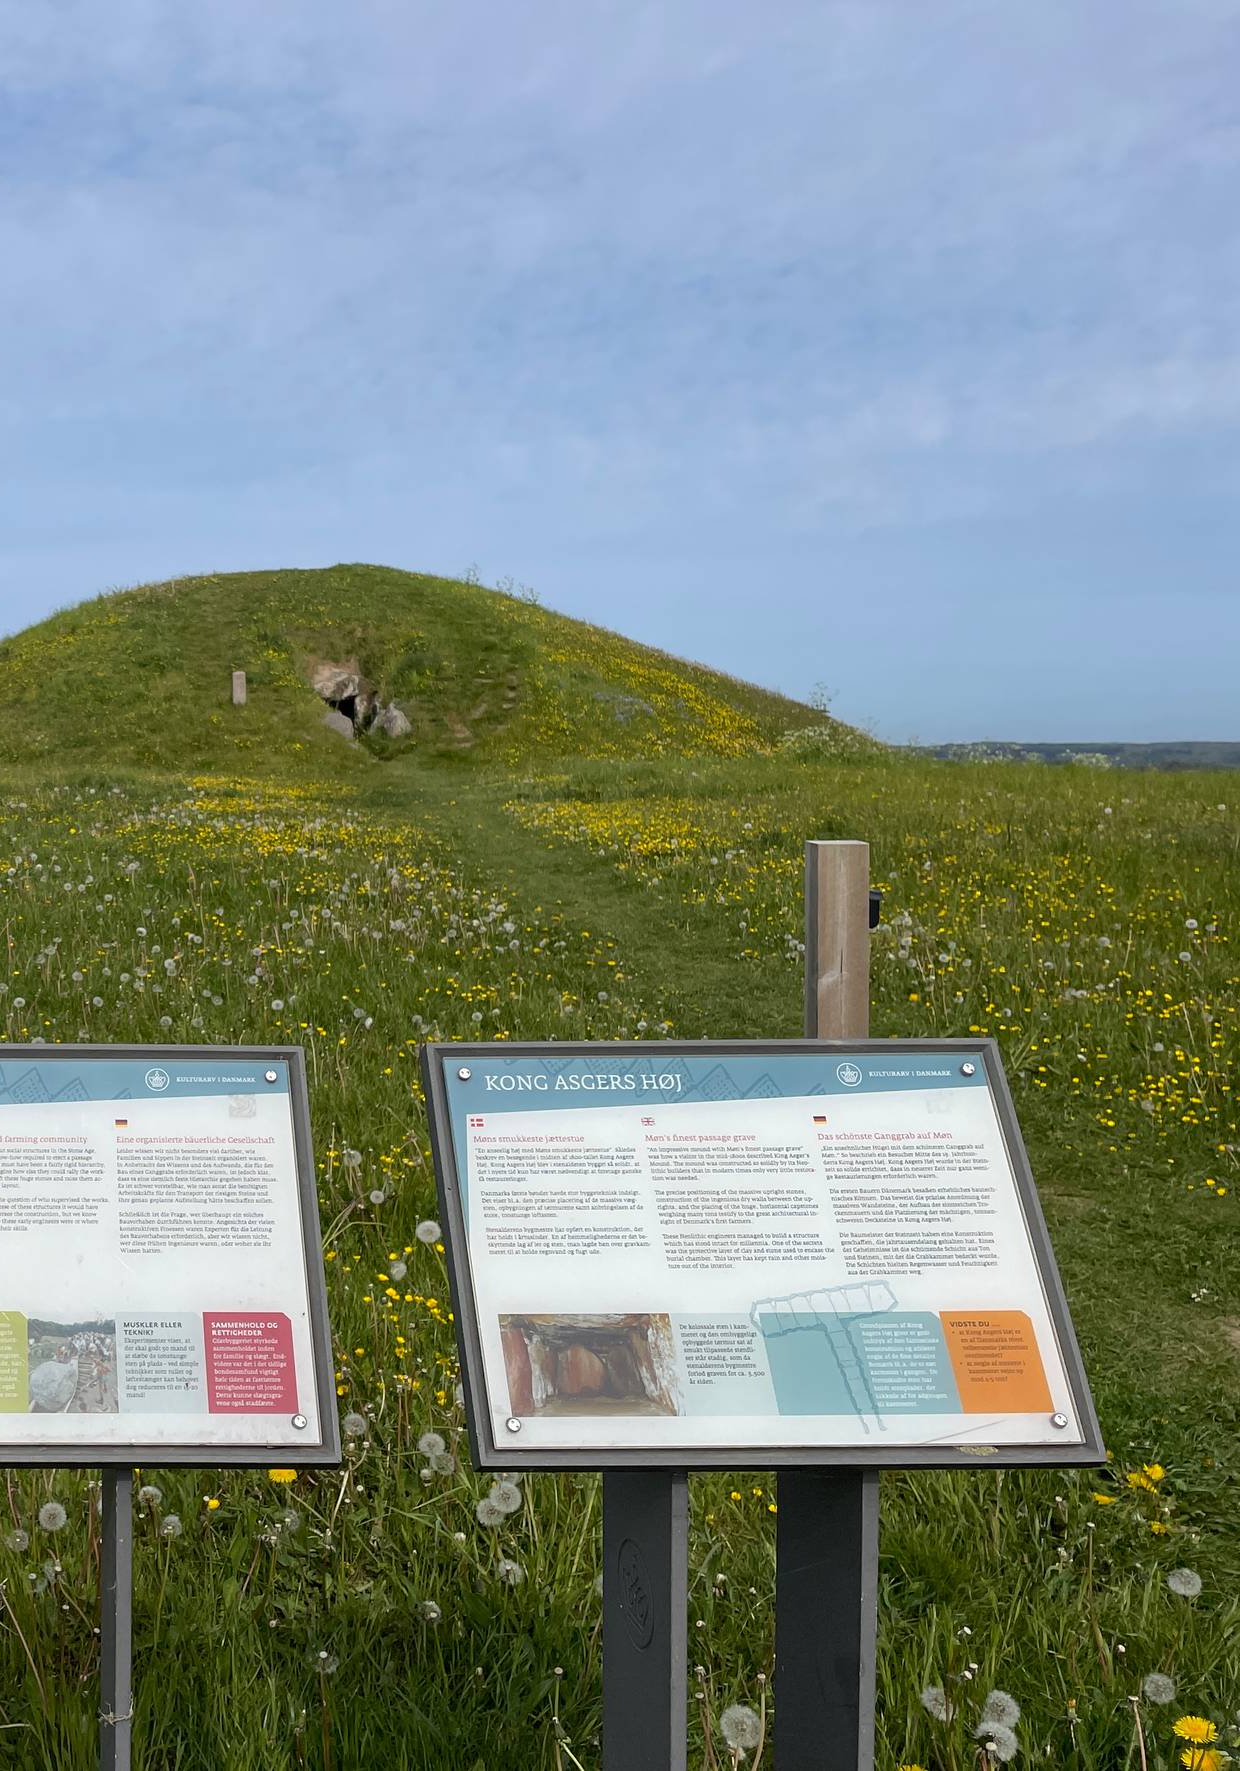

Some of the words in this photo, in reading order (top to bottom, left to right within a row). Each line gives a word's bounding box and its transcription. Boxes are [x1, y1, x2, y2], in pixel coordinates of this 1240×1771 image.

[485, 1075, 547, 1091] KONG
[554, 1074, 636, 1090] ASGERS
[642, 1074, 681, 1092] HØJ
[5, 1136, 38, 1144] farming
[136, 1136, 182, 1144] organisierte
[874, 1132, 915, 1142] Ganggrab
